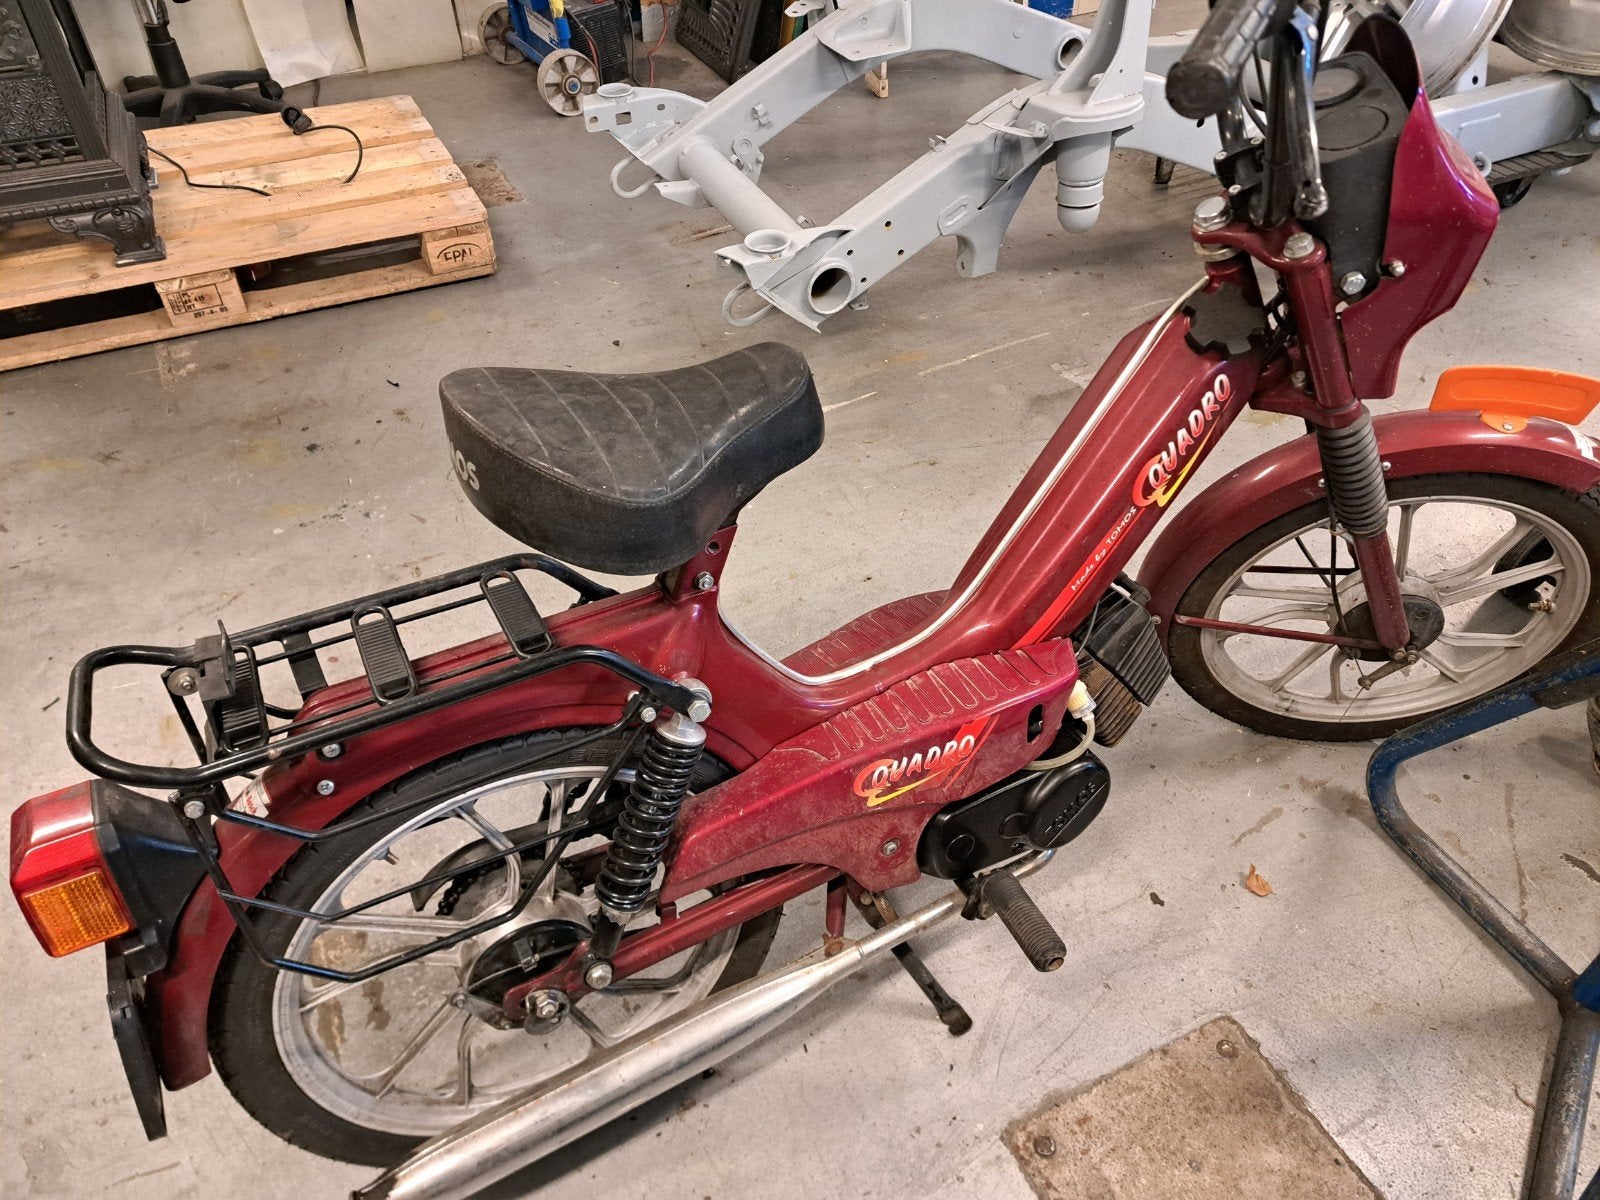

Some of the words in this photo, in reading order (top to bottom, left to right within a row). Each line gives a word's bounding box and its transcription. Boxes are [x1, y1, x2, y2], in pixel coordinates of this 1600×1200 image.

[1142, 373, 1231, 494] QUADRO
[1105, 505, 1138, 545] TOMOS
[863, 734, 975, 796] QUADRO
